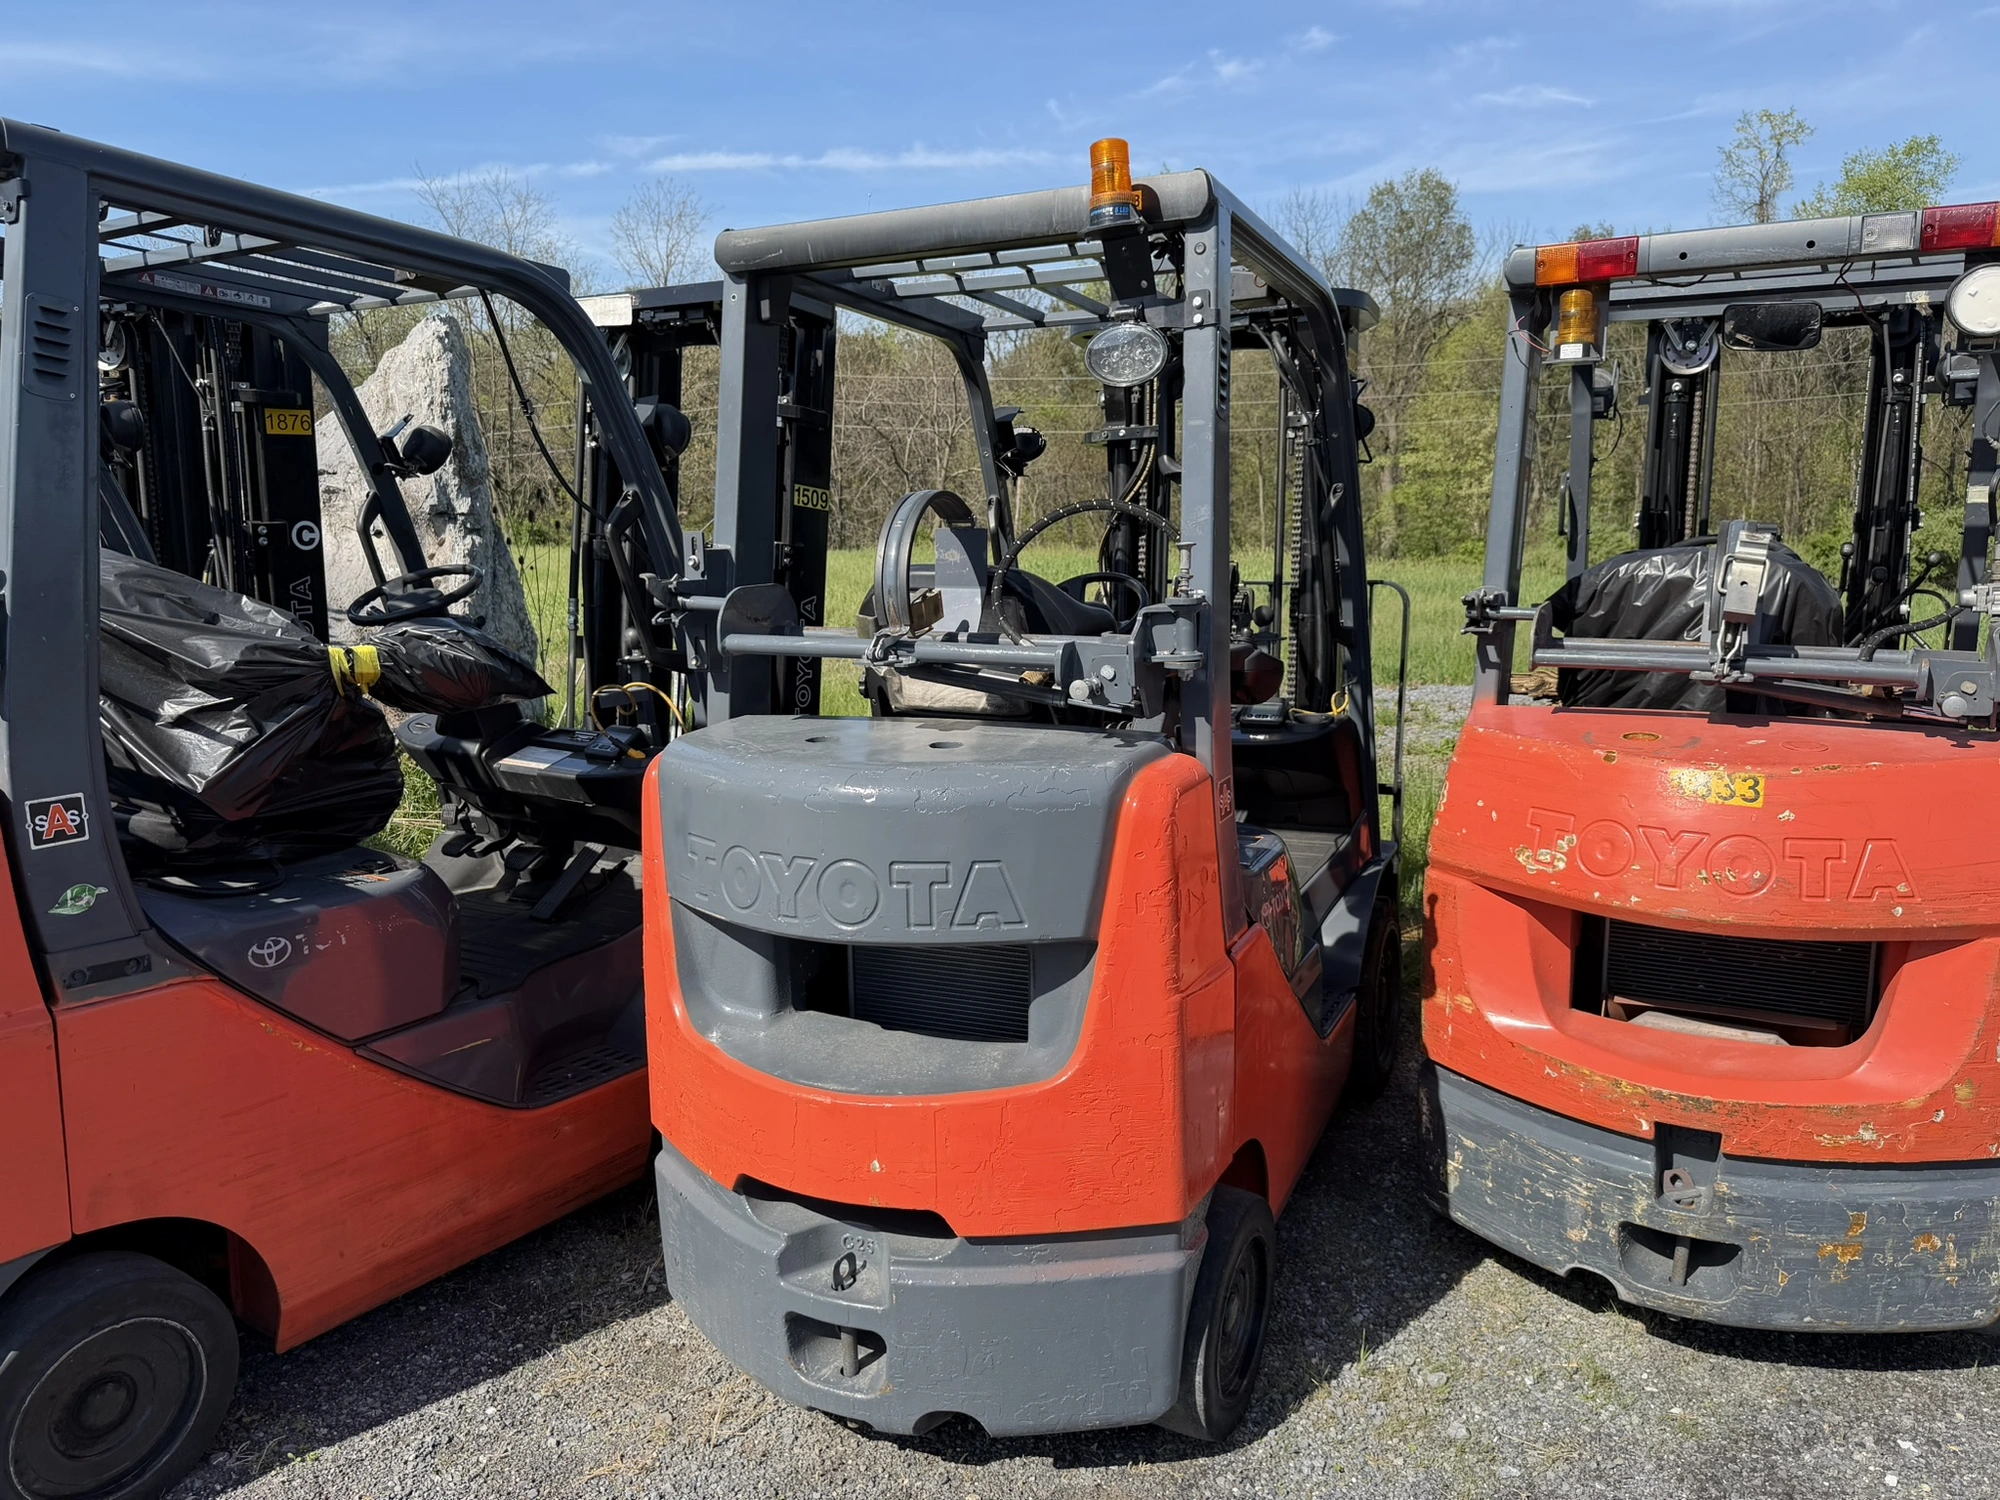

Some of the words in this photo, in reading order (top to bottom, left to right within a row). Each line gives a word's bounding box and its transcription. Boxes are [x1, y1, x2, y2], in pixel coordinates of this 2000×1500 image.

[266, 413, 311, 431] 1876
[795, 486, 828, 509] 1509
[687, 832, 1029, 930] TOYOTA
[1527, 807, 1921, 901] TOYOTA
